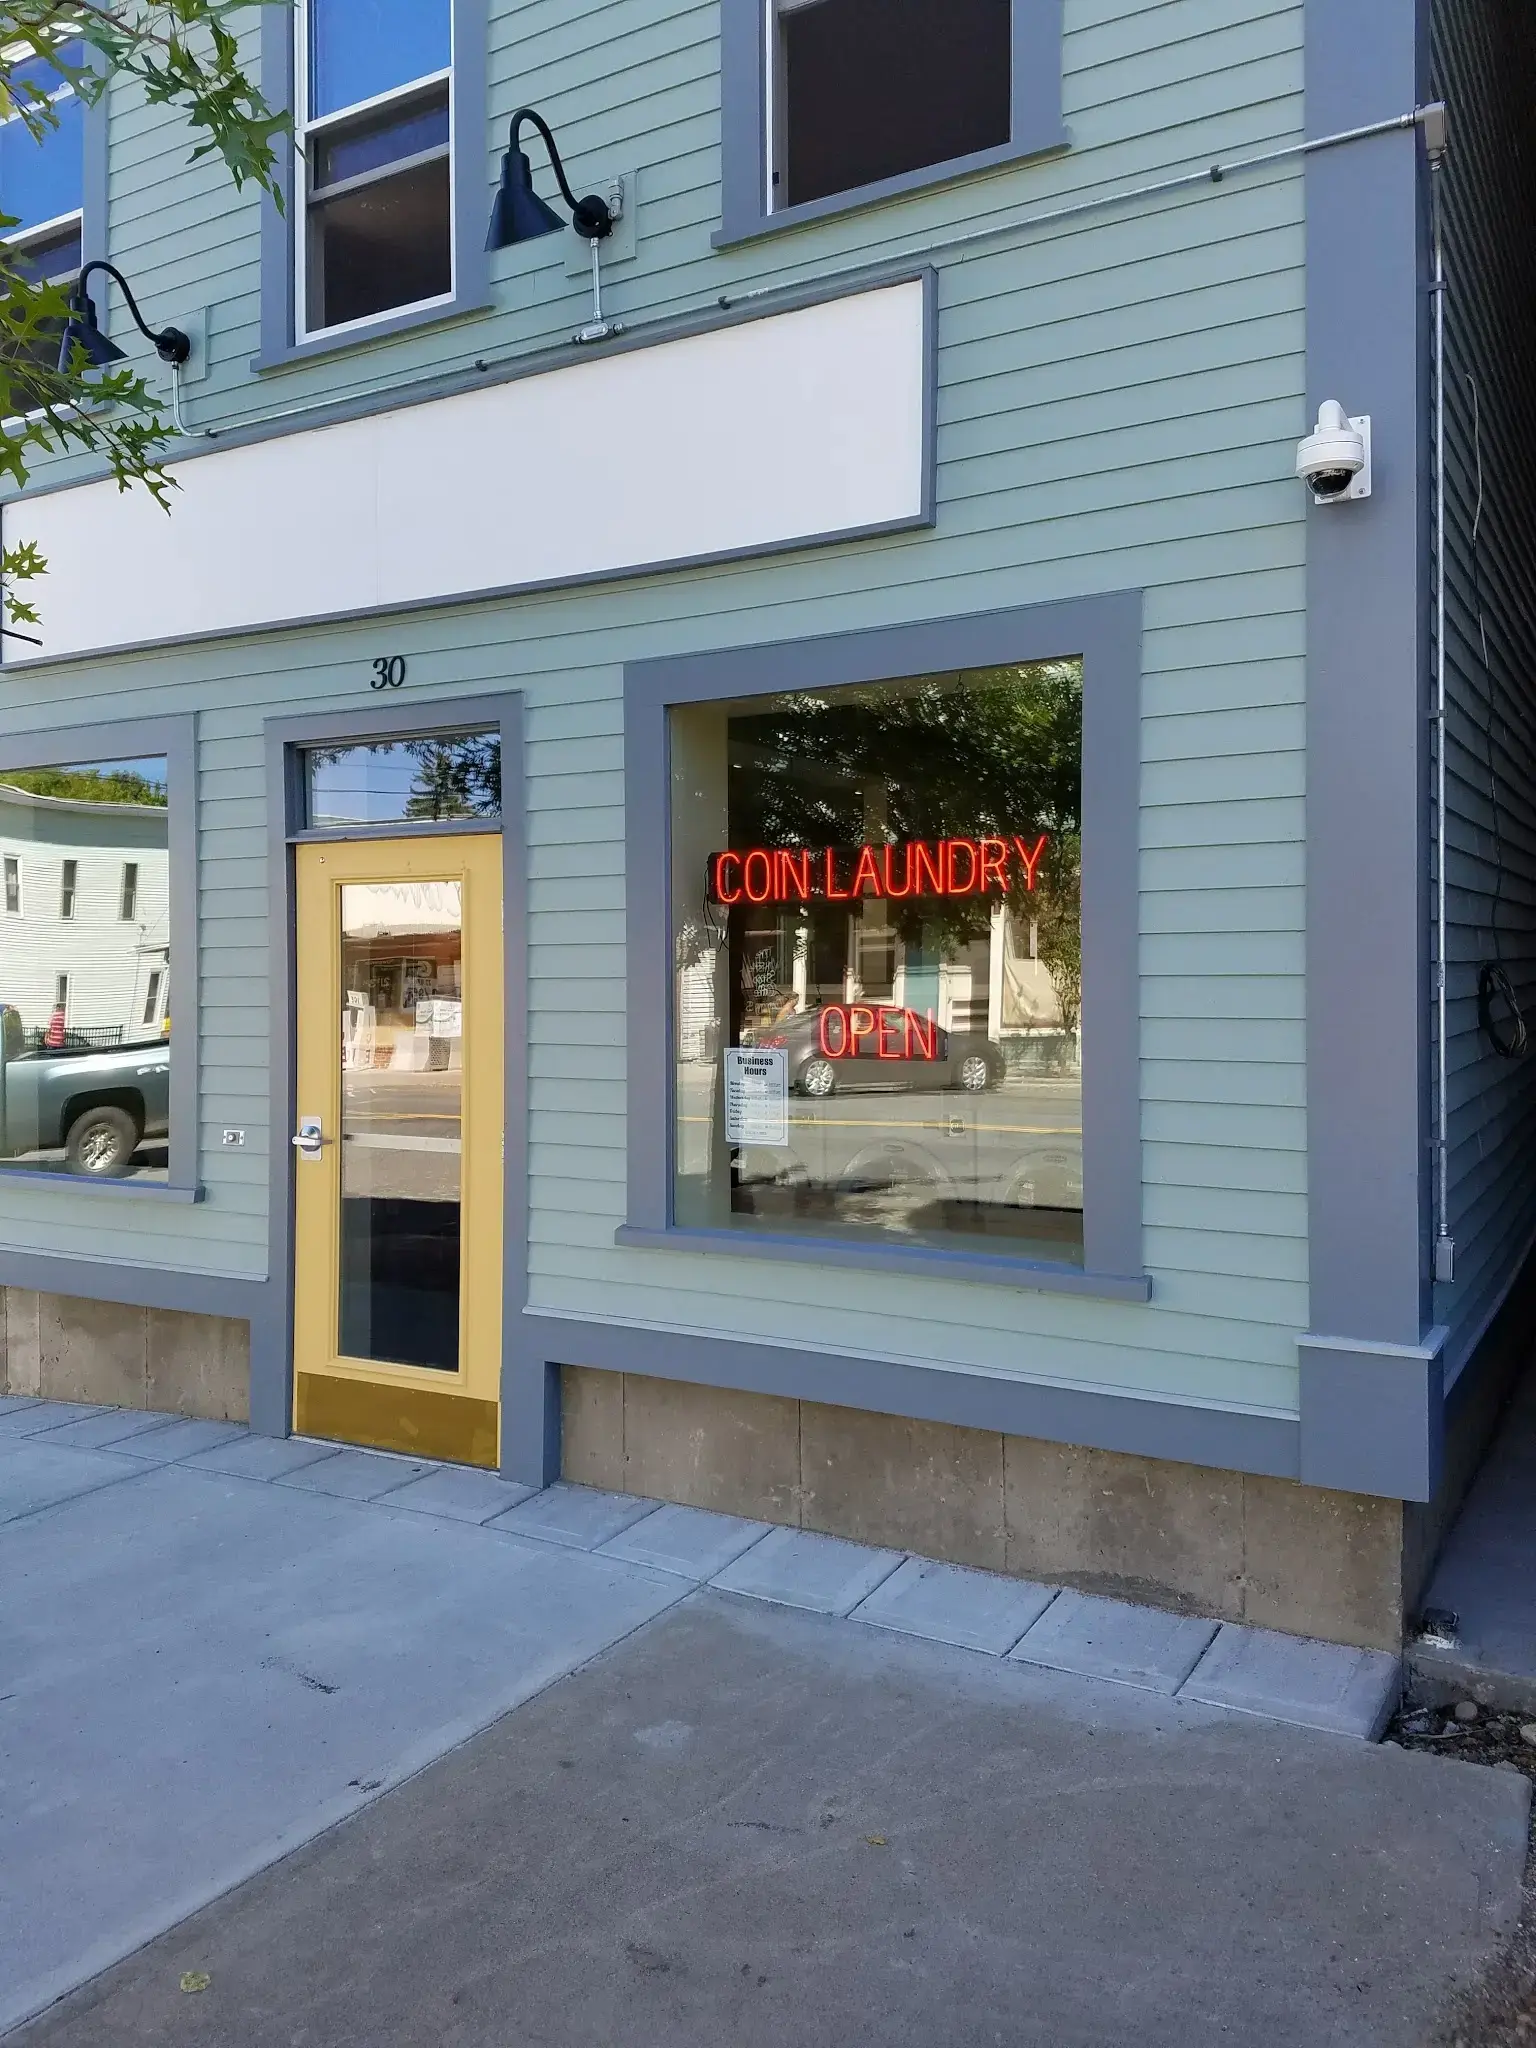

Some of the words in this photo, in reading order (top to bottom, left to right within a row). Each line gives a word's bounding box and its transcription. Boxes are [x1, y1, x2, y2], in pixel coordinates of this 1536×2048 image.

[370, 656, 406, 690] 30
[716, 848, 809, 903] COIN
[827, 836, 1047, 898] LAUNDRY
[820, 1005, 935, 1059] OPEN
[737, 1056, 774, 1066] Business
[744, 1066, 767, 1076] Hours
